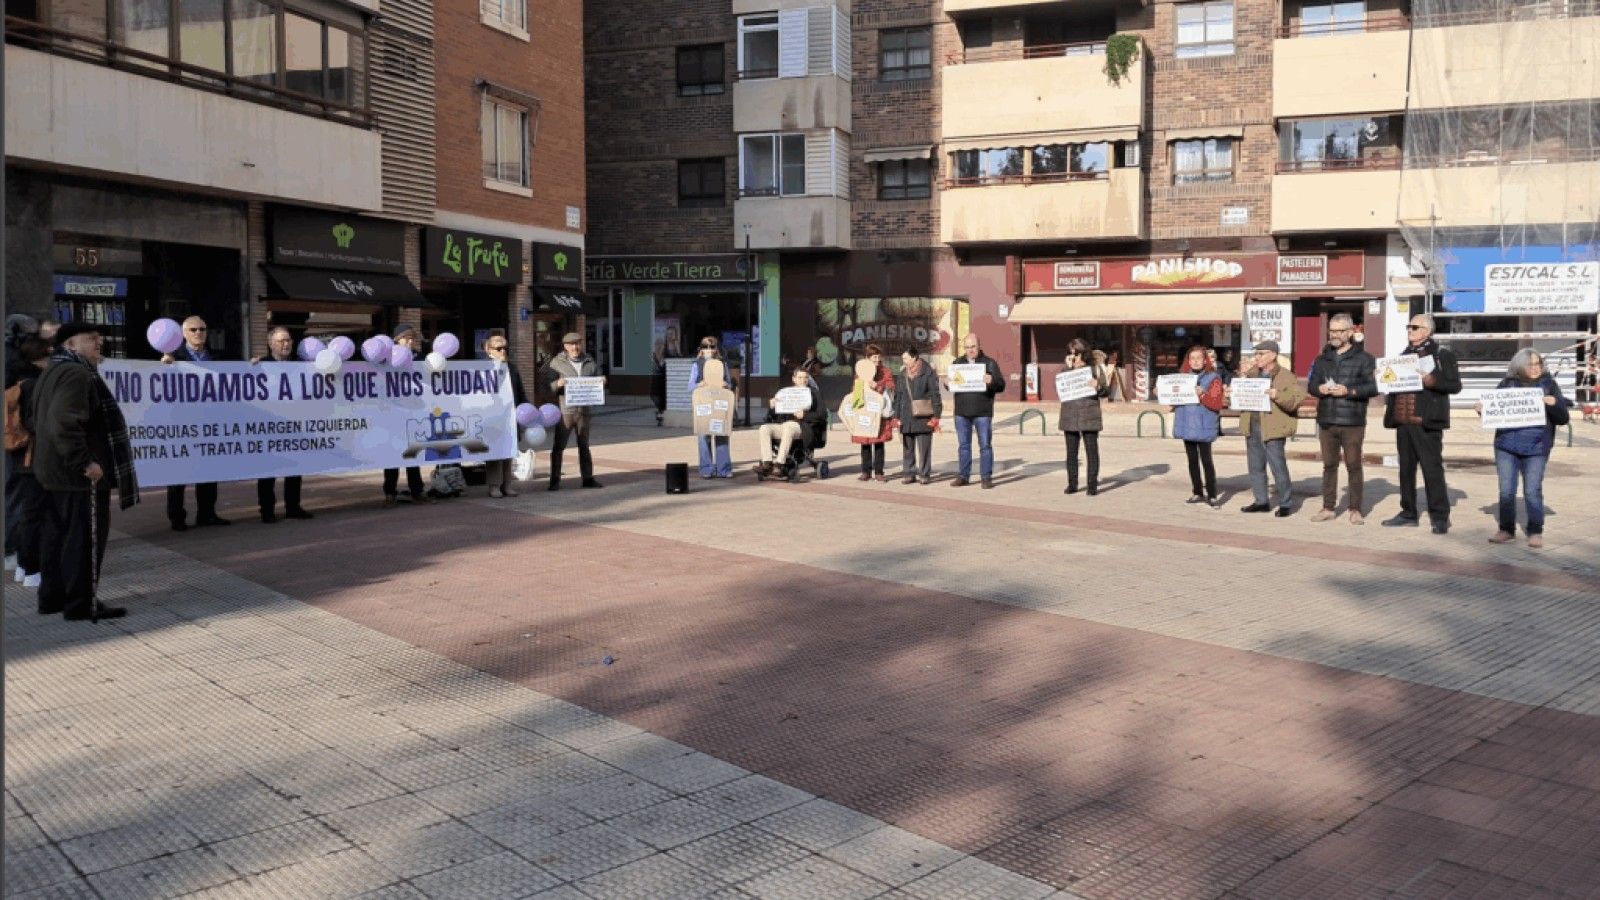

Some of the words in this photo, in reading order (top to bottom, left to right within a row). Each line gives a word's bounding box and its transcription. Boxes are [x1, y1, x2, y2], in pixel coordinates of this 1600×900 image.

[75, 247, 98, 266] 55
[442, 233, 462, 274] La
[466, 236, 509, 278] Trufa
[585, 260, 616, 279] ería
[620, 261, 670, 279] Verde
[673, 261, 722, 279] Tierra
[1131, 257, 1244, 282] PANISHOP
[1489, 265, 1560, 279] ESTICAL
[841, 323, 941, 345] PANISHOP
[105, 371, 143, 403] "NO
[150, 371, 270, 403] CUIDAMOS
[277, 371, 293, 401] A
[301, 371, 337, 400] LOS
[343, 371, 379, 403] QUE
[385, 370, 425, 399] NOS
[431, 369, 505, 396] CUIDAN"
[1496, 390, 1543, 399] CUIDAMOS
[1486, 409, 1506, 417] NOS
[1507, 407, 1540, 415] CUIDAN
[1498, 399, 1535, 409] QUIENES
[129, 424, 199, 441] RROQUIAS
[202, 423, 219, 438] DE
[224, 422, 241, 437] LA
[245, 420, 301, 436] MARGEN
[305, 417, 368, 434] IZQUIERDA
[133, 444, 168, 459] NTRA
[172, 443, 190, 459] LA
[194, 441, 243, 457] "TRATA
[247, 440, 263, 455] DE
[267, 436, 342, 453] PERSONAS"
